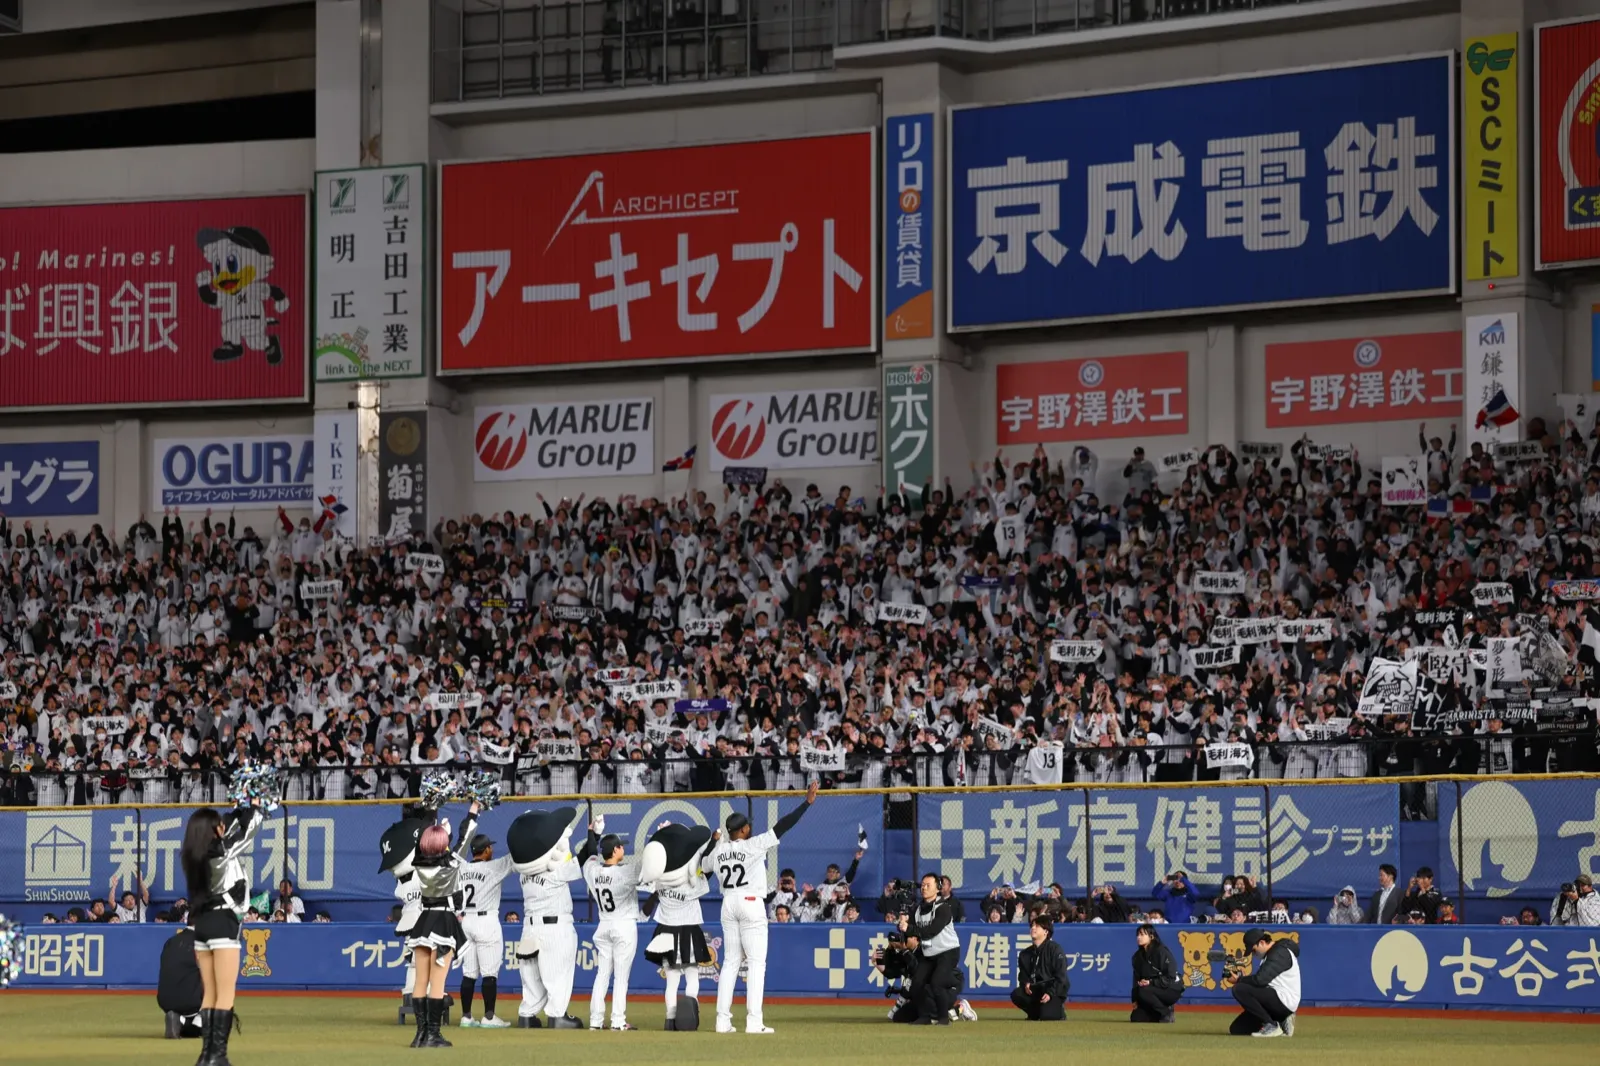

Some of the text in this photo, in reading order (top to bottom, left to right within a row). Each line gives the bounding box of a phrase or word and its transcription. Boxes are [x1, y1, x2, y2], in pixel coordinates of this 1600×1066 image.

[1477, 76, 1505, 277] SCミート
[612, 188, 739, 214] ARCHICEPT
[896, 121, 924, 288] リロの賃貸
[967, 115, 1440, 275] 京成電鉄
[37, 245, 175, 270] Marines!
[330, 233, 355, 319] 明正
[383, 215, 409, 353] 吉田工業
[453, 218, 863, 348] アーキセプト
[1479, 331, 1505, 346] KM
[325, 360, 412, 375] link to the NEXT
[1270, 366, 1463, 414] 宇野澤鉄工
[527, 400, 653, 438] MARUEI
[1001, 386, 1183, 433] 宇野澤鉄工
[537, 439, 637, 472] Group
[776, 427, 877, 463] Group
[890, 387, 928, 507] ホクト
[385, 464, 414, 541] 菊屋
[1002, 526, 1016, 540] 13
[1199, 576, 1239, 589] 毛利海大
[884, 604, 922, 620] 毛利海大
[1056, 644, 1097, 657] 毛利海大
[634, 681, 676, 695] 毛利海大
[804, 751, 839, 766] 毛利海大
[1042, 752, 1056, 769] 13
[109, 814, 335, 892] 新和
[717, 851, 746, 864] POLANCO
[595, 875, 613, 885] MOURI
[720, 863, 749, 889] 22
[464, 884, 476, 908] 2
[595, 888, 615, 912] 13
[24, 932, 104, 977] 昭和
